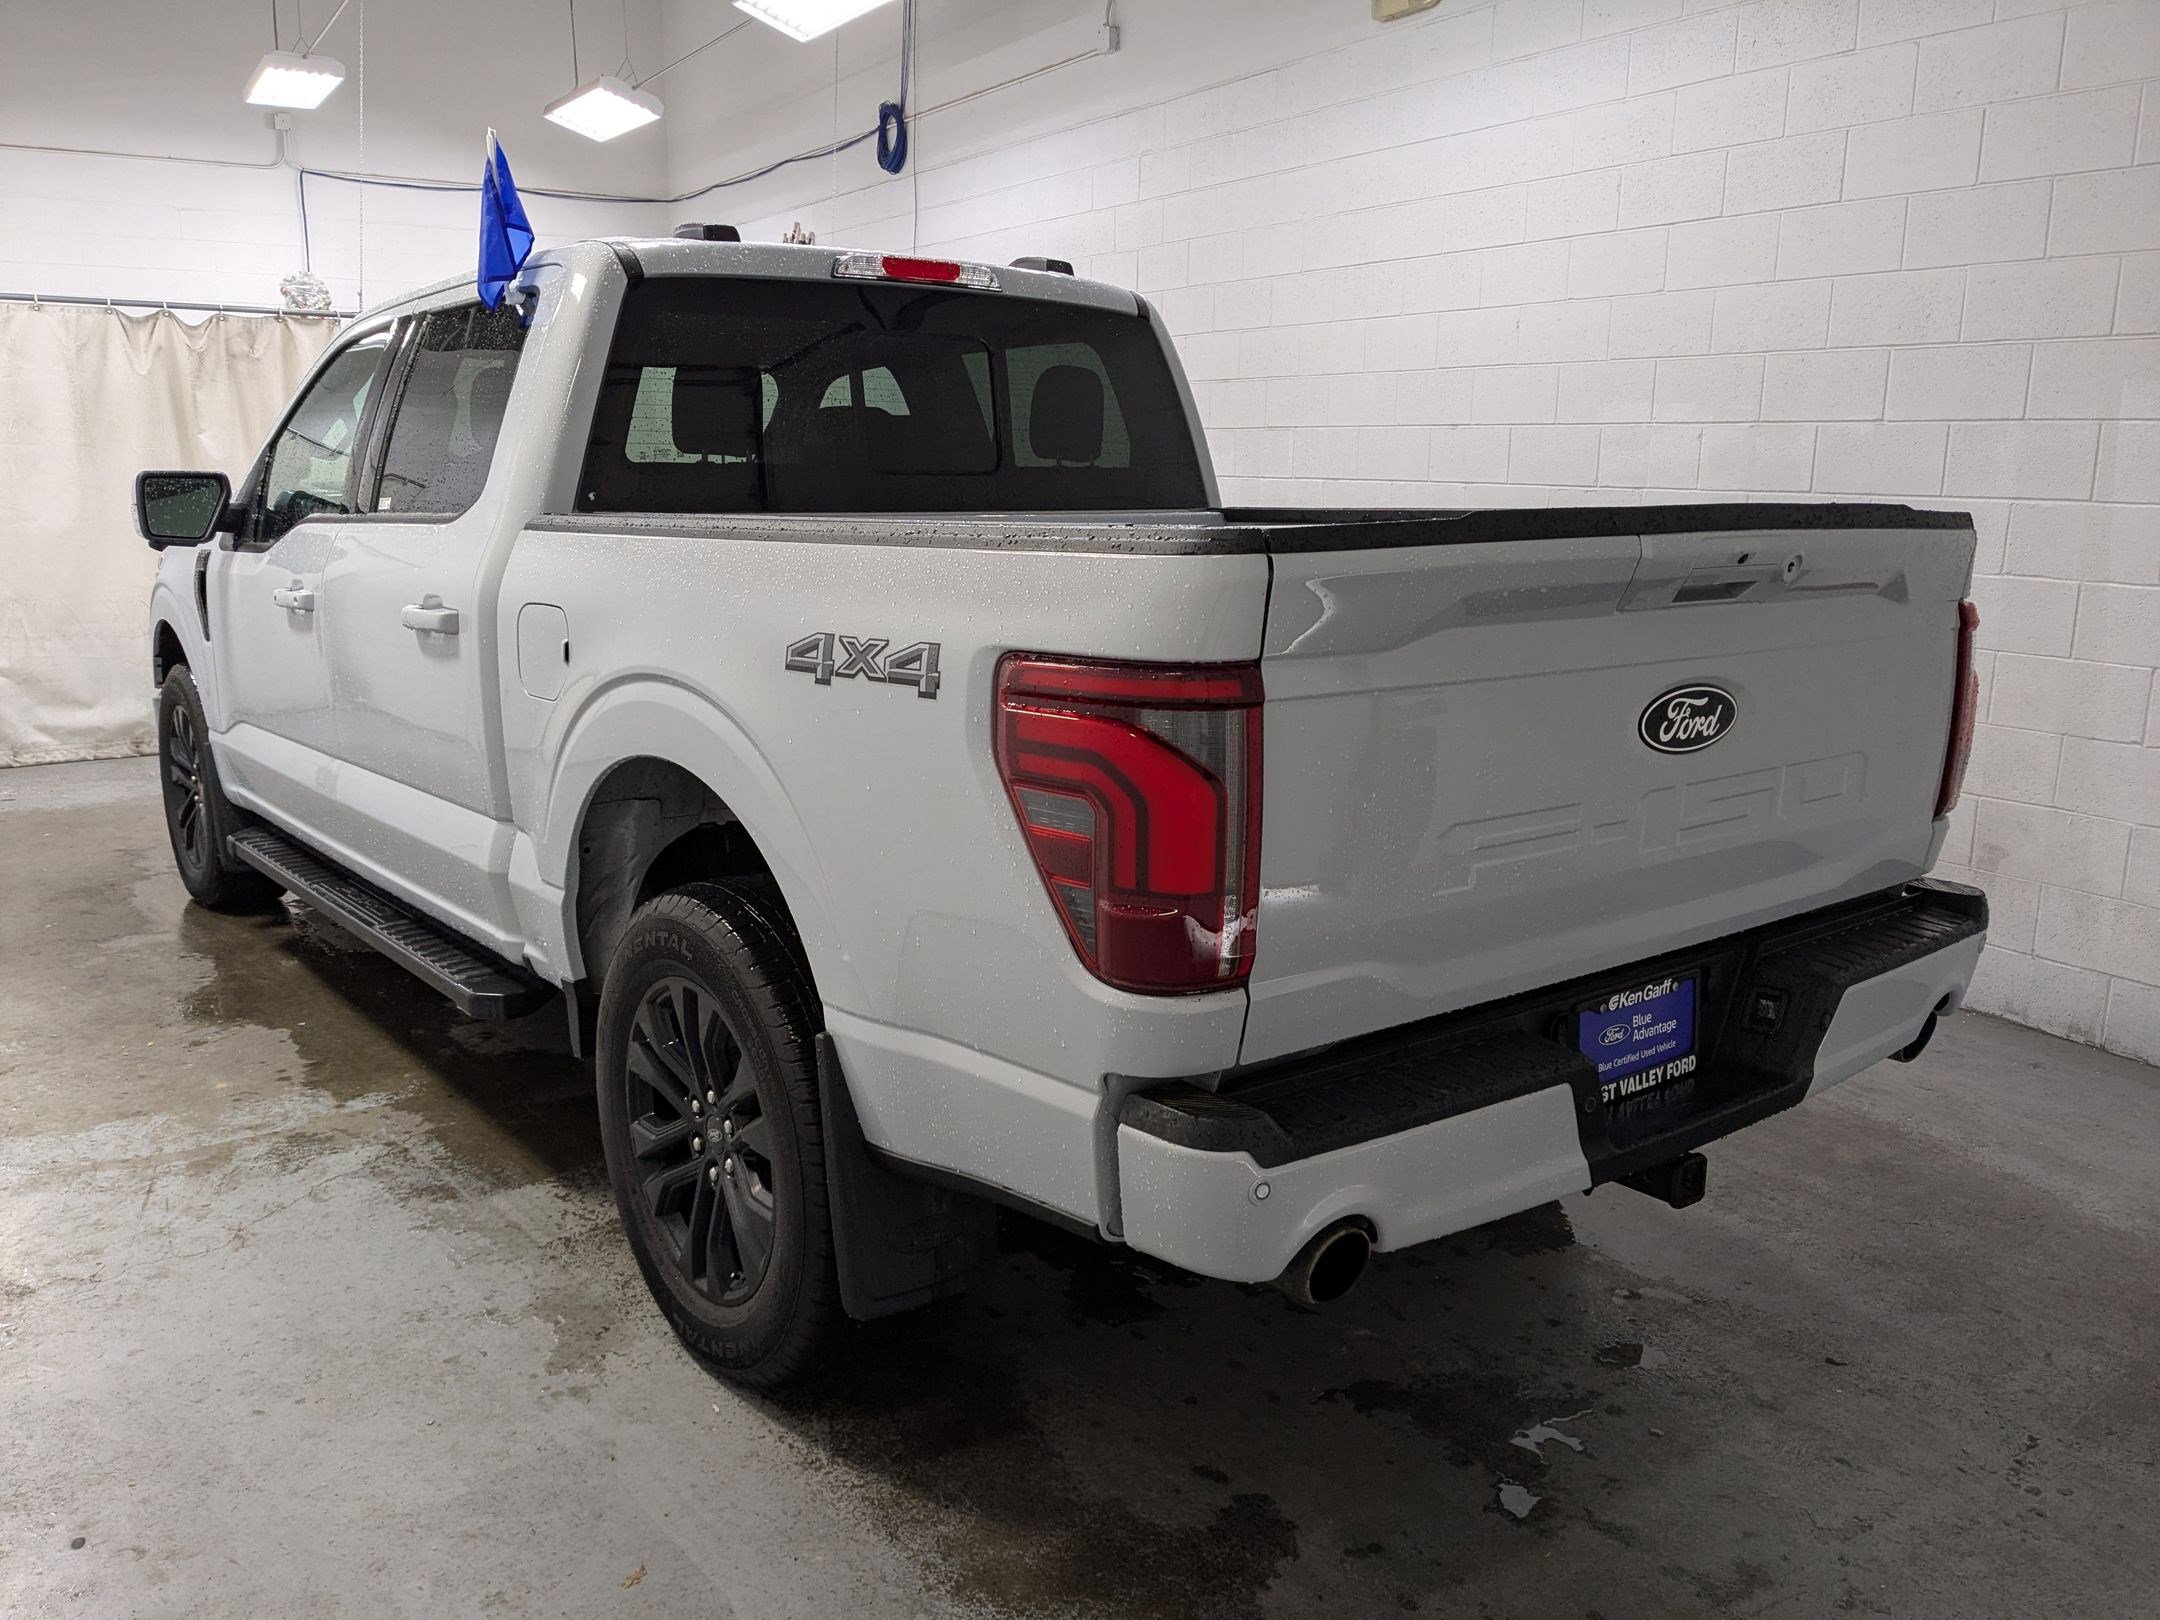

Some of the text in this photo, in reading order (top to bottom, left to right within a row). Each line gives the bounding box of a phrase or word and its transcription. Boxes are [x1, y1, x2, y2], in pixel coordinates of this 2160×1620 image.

[1660, 697, 1723, 743] Ford
[1619, 978, 1673, 1009] Ken Garff
[1605, 1027, 1625, 1043] Ford
[1632, 1013, 1652, 1027] Blue
[1632, 1019, 1677, 1042] Advantage
[1598, 1039, 1677, 1073] Blue Certified Used Vehicle
[1620, 1065, 1664, 1096] VALLEY
[1667, 1055, 1696, 1080] FORD
